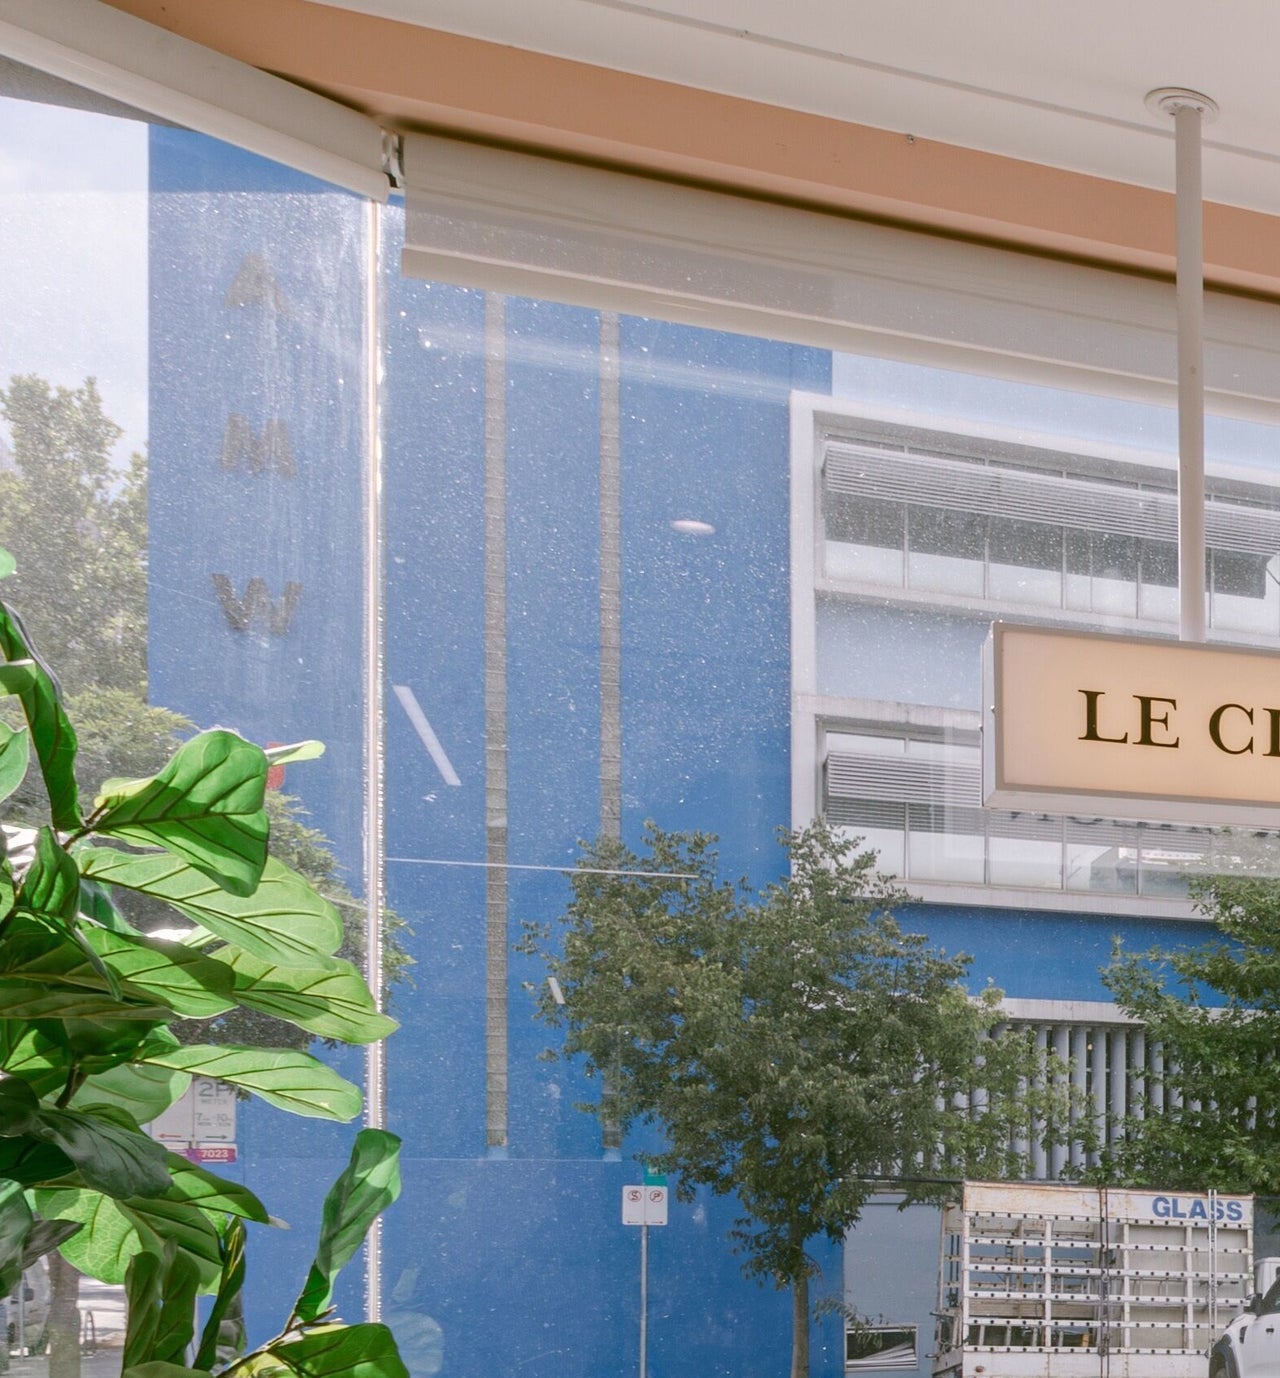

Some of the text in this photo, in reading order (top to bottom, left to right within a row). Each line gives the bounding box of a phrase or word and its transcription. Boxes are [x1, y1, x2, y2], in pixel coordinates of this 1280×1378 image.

[1077, 689, 1181, 748] LE
[202, 1150, 228, 1158] 7023
[1151, 1196, 1243, 1222] GLASS
